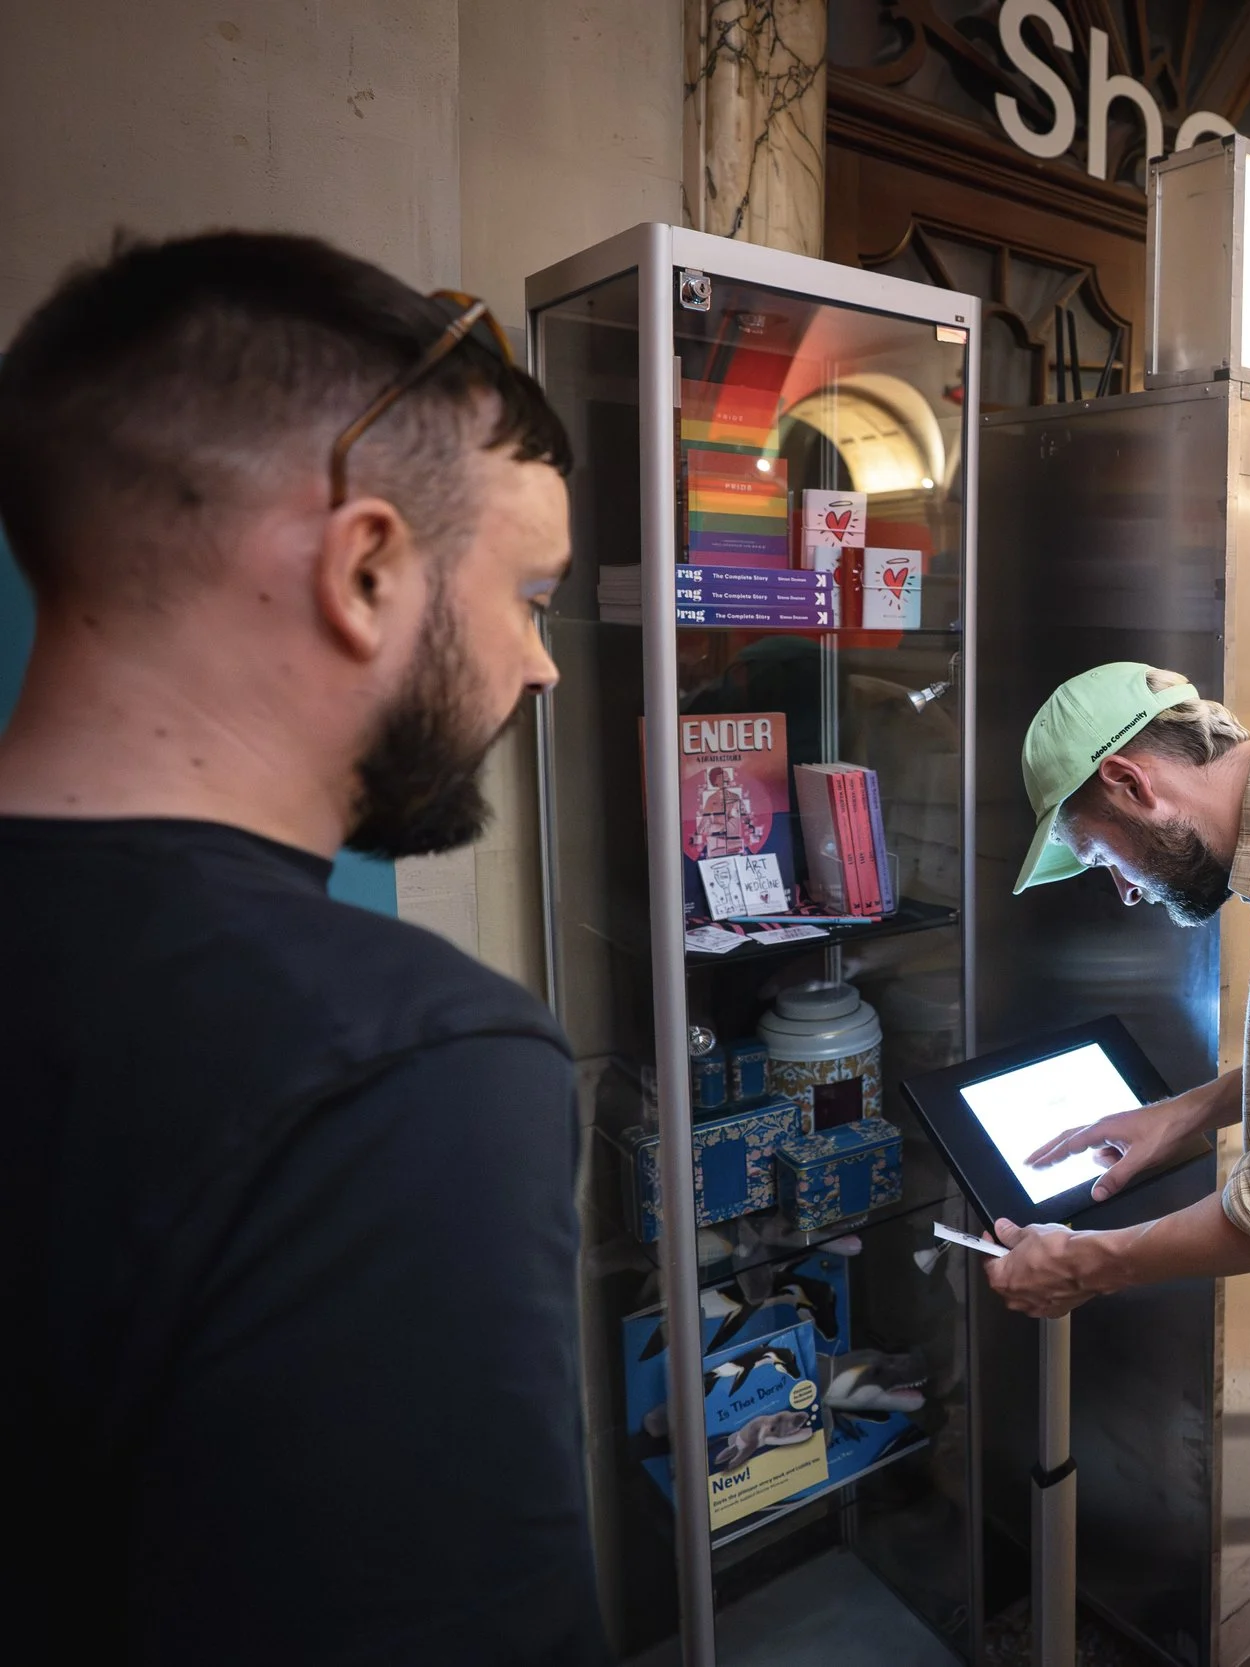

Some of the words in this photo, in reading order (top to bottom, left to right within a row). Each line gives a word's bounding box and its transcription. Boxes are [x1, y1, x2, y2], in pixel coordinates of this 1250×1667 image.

[677, 569, 703, 582] rag
[677, 588, 702, 602] rag
[683, 719, 772, 754] ENDER
[1091, 742, 1112, 762] Adobe
[1111, 710, 1147, 743] Community
[746, 857, 767, 874] ART
[712, 1467, 750, 1494] New!
